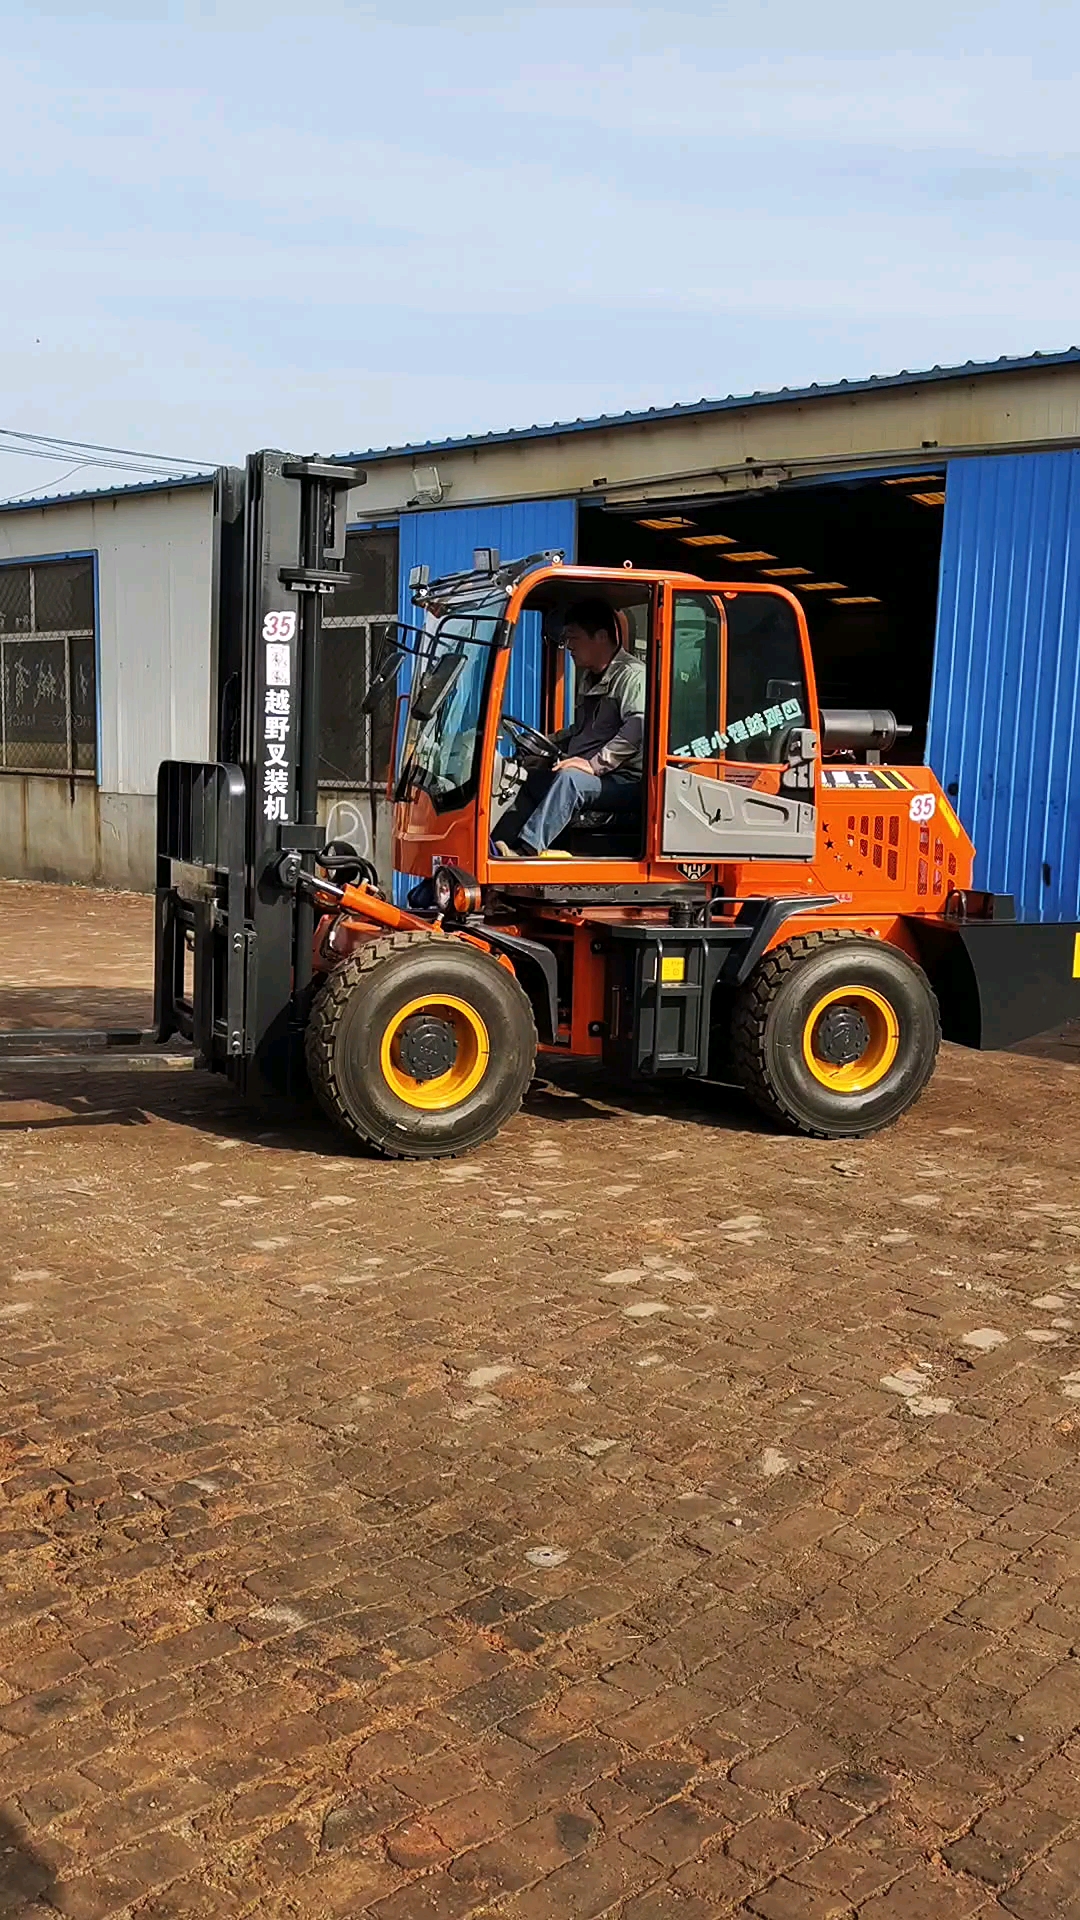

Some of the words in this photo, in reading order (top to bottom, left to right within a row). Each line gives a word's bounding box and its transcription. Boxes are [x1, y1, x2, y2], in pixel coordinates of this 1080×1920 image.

[266, 616, 292, 636] 35
[264, 689, 290, 820] 越野叉装机
[912, 797, 933, 817] 35
